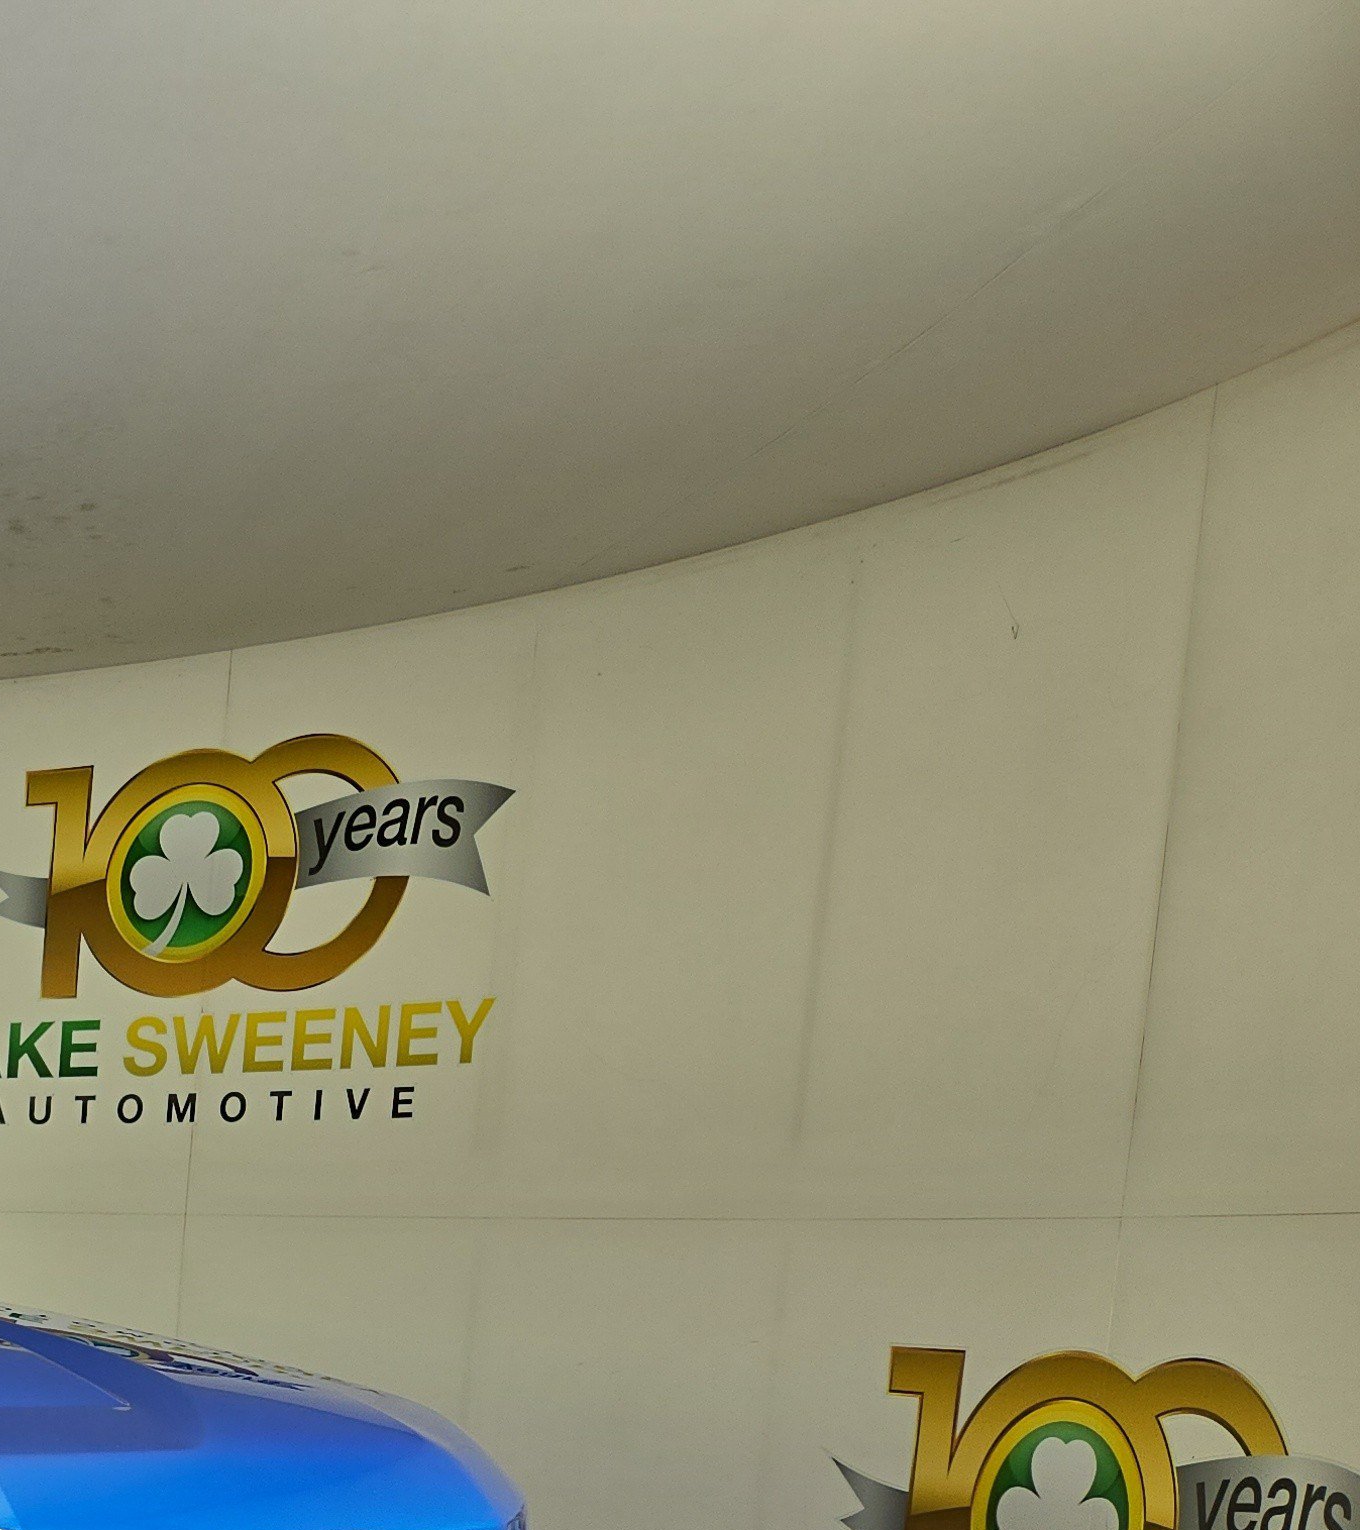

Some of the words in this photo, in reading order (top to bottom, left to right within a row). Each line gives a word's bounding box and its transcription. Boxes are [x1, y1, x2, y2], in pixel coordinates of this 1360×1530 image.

[25, 733, 410, 999] 100
[308, 795, 464, 875] years
[122, 997, 496, 1078] SWEENEY
